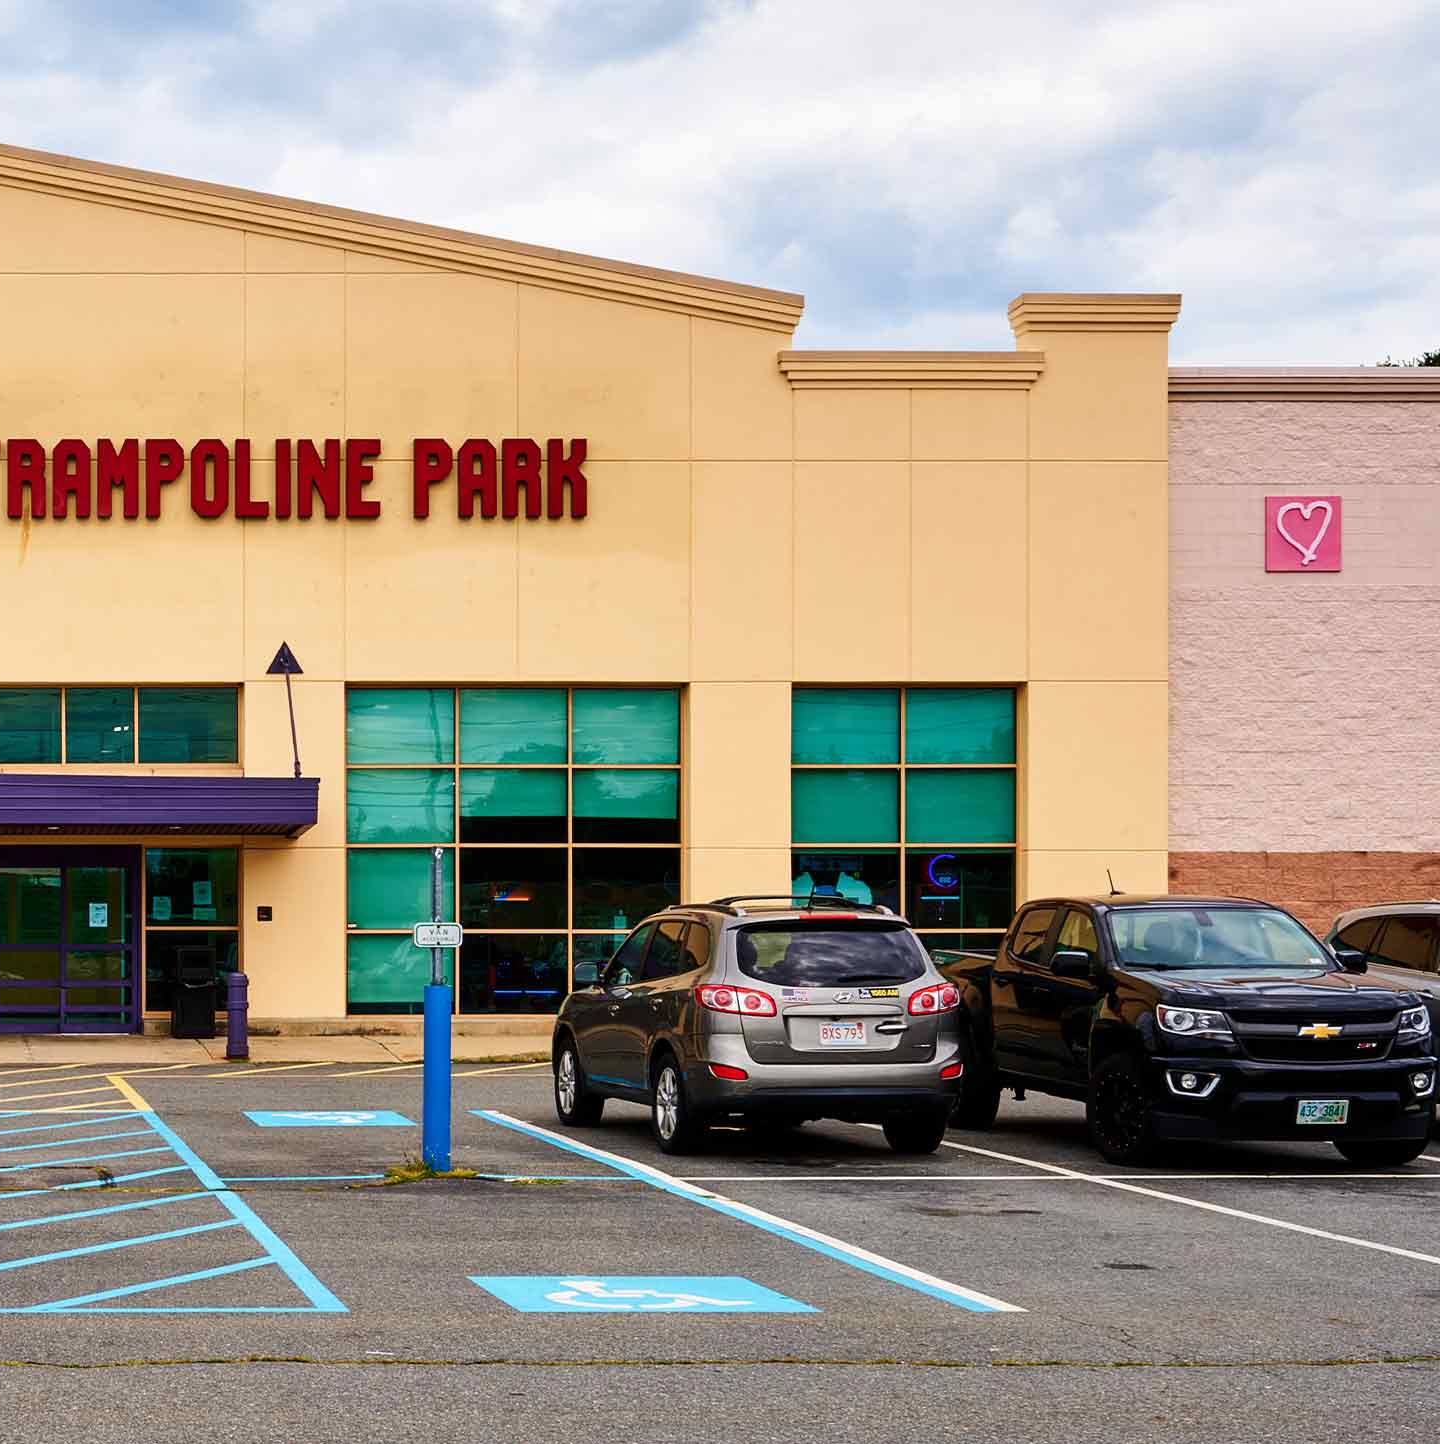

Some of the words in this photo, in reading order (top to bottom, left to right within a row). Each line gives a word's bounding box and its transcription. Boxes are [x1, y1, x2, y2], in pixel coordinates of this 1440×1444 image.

[412, 437, 588, 519] PARK
[844, 1027, 864, 1040] 793
[1300, 1105, 1318, 1117] 432
[1322, 1105, 1345, 1117] 3841
